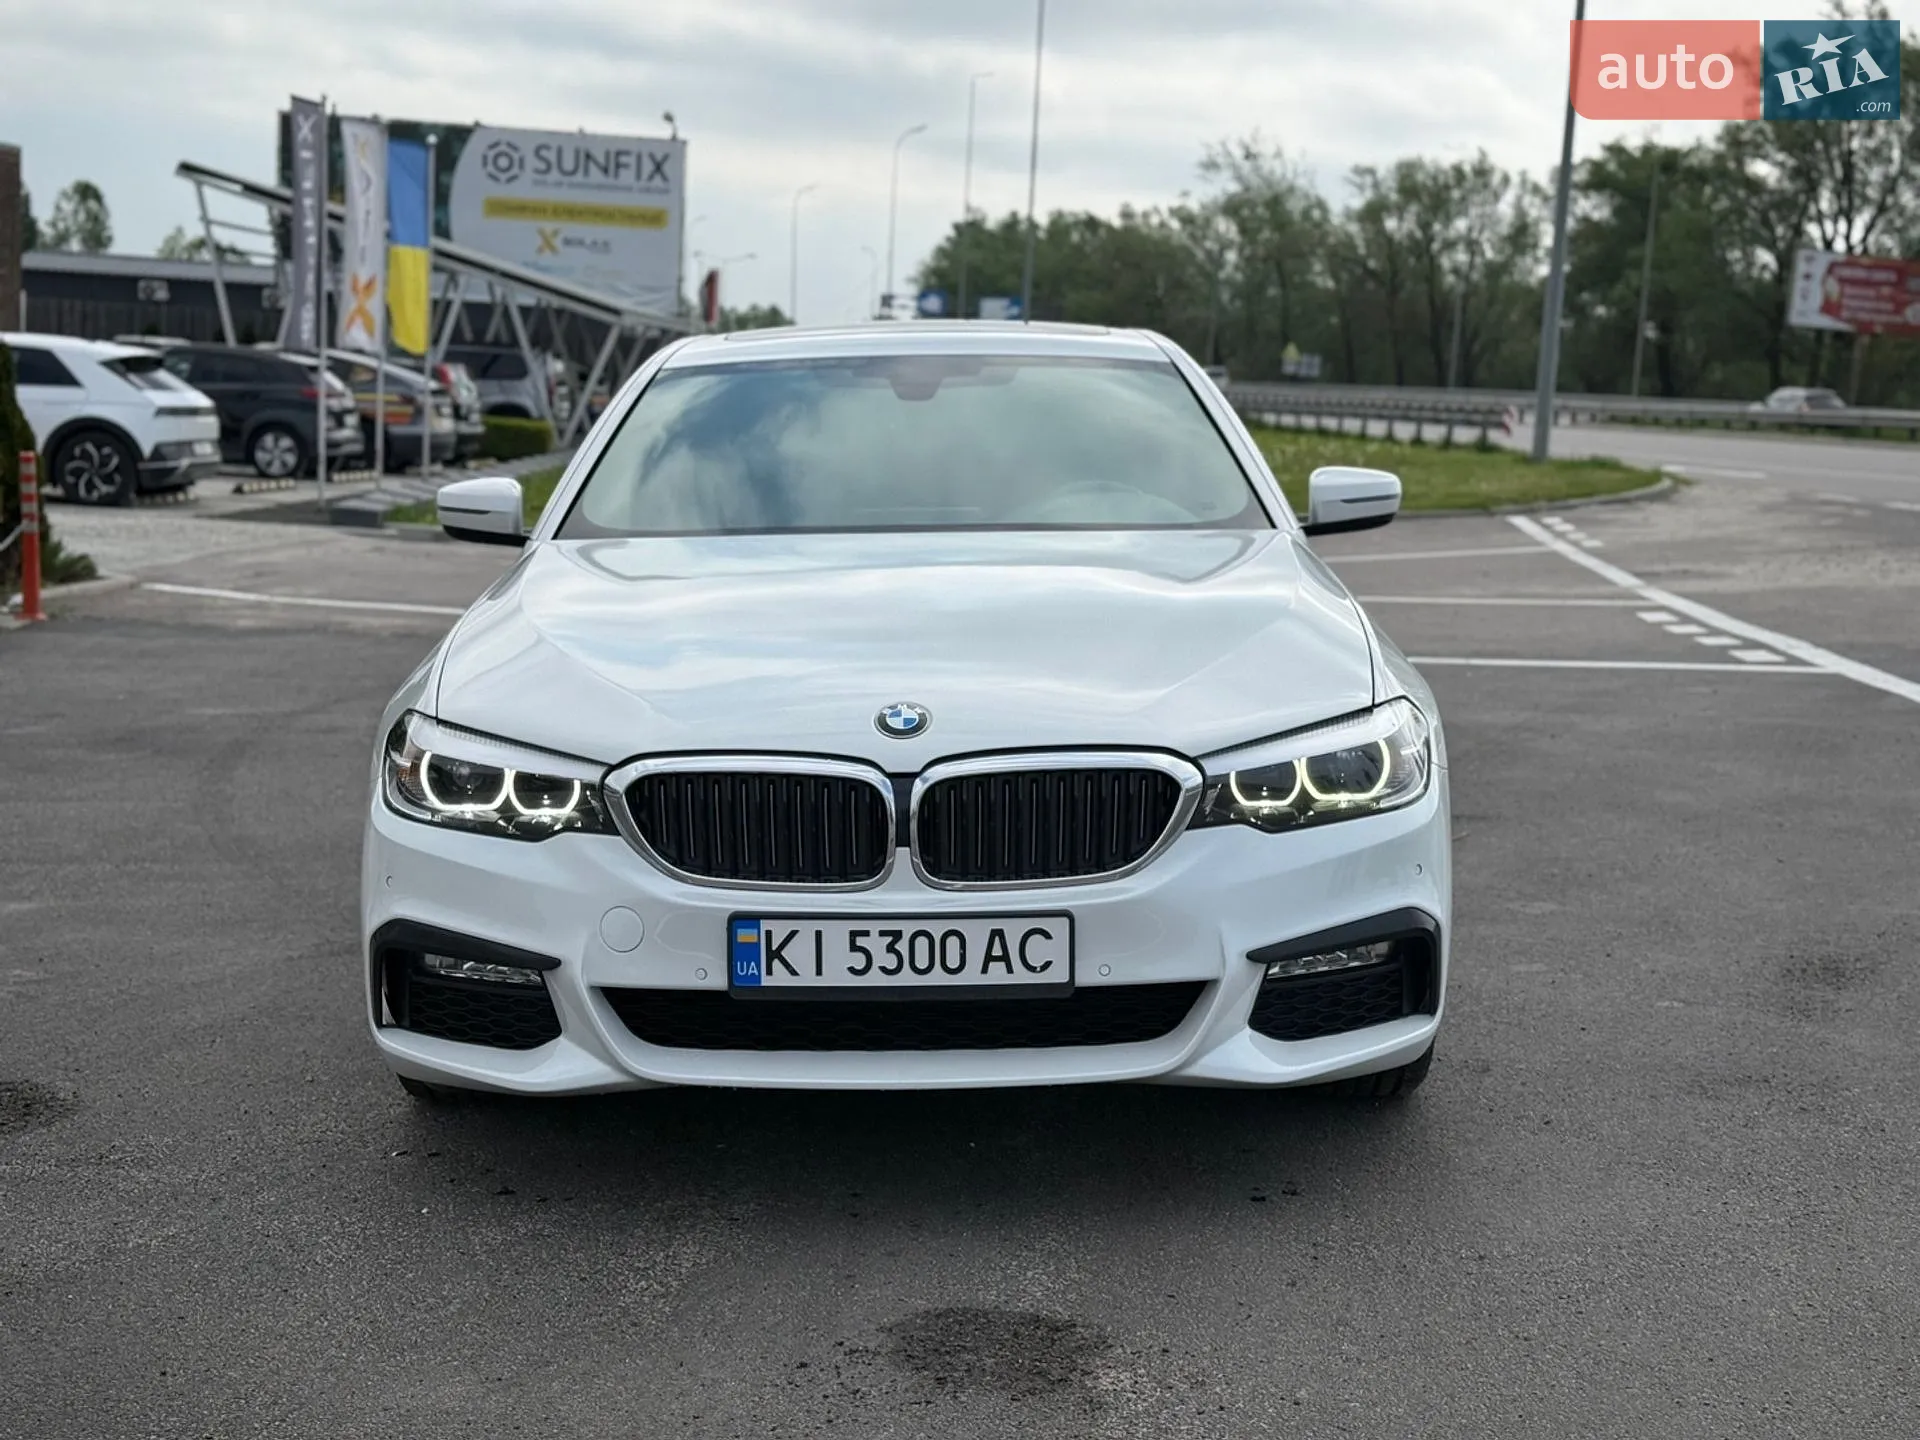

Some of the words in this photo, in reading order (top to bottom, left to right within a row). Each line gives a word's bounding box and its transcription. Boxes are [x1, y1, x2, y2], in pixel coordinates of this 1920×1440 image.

[532, 143, 670, 184] SUNFIX
[737, 961, 759, 976] UA
[764, 929, 824, 977] KI
[847, 929, 967, 976] 5300
[980, 927, 1054, 975] AC
